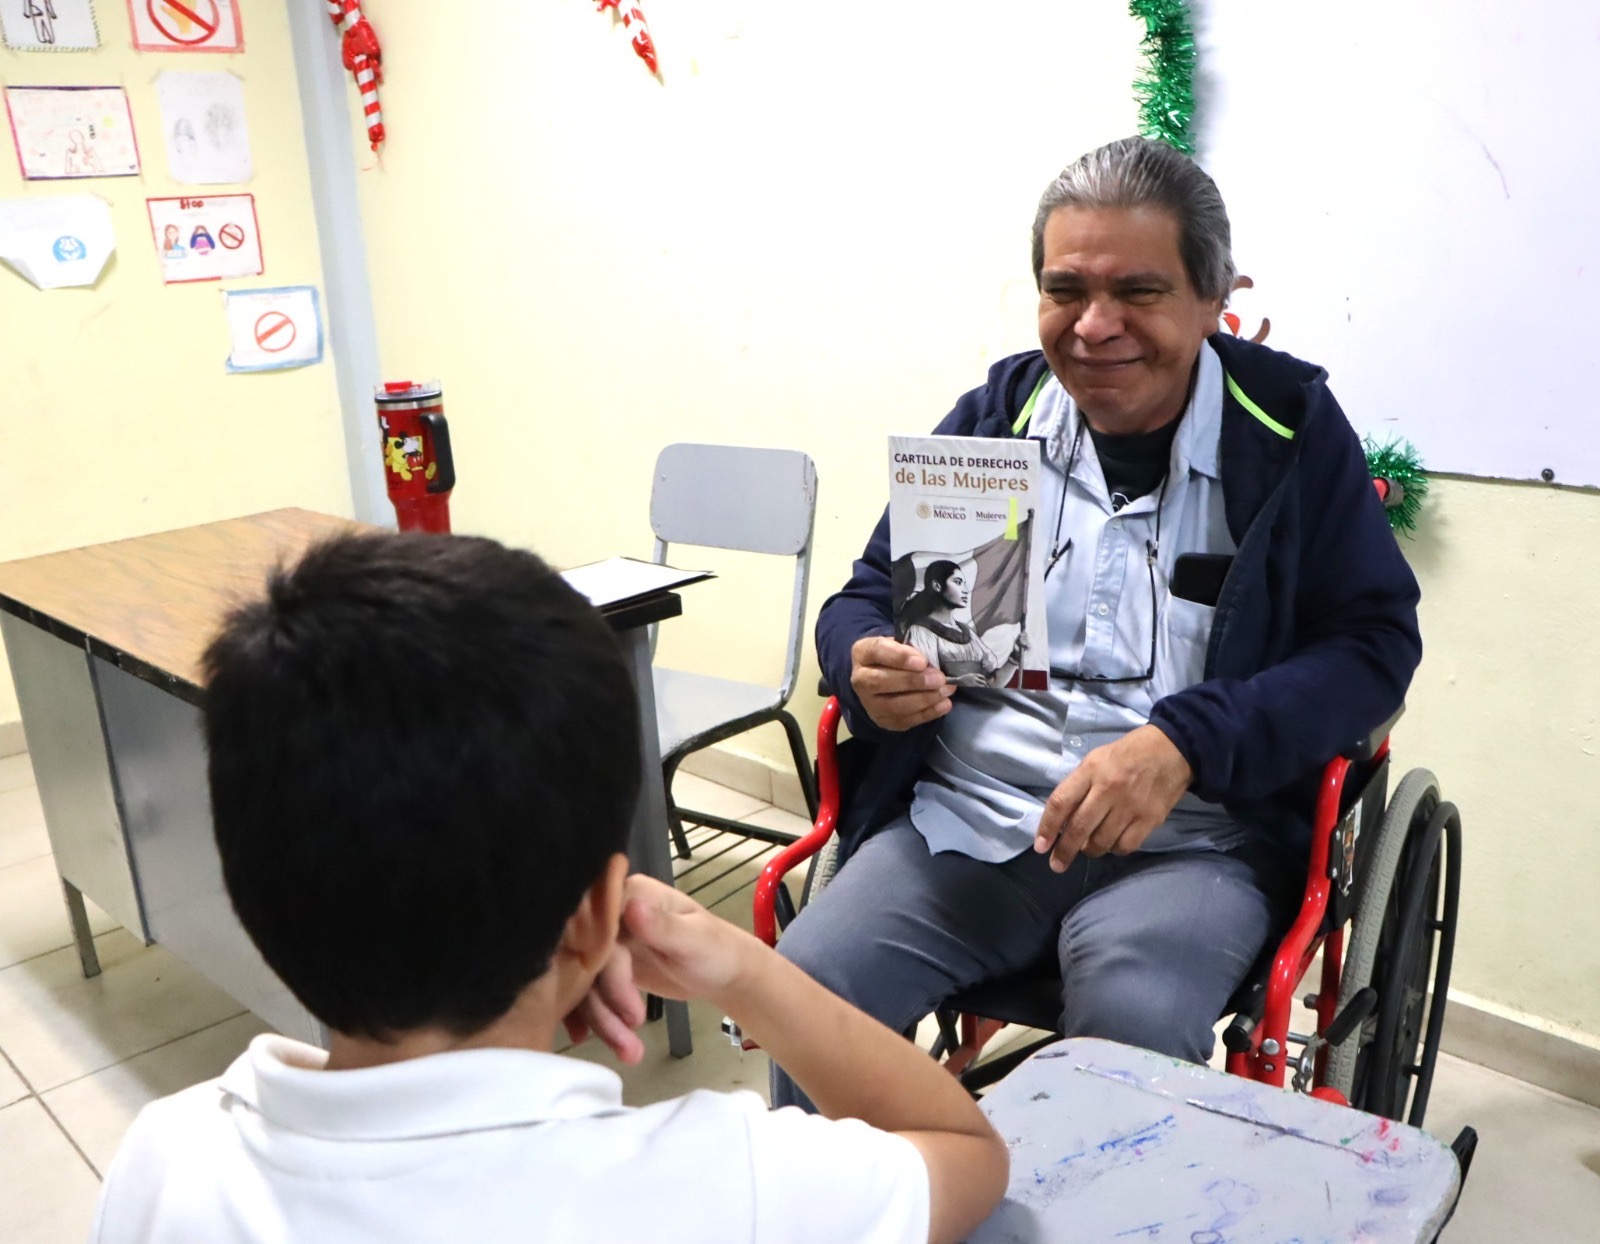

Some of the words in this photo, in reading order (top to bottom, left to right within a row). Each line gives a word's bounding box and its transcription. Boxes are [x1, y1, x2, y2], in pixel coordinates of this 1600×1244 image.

[894, 453, 947, 466] CARTILLA
[950, 457, 964, 467] DE
[967, 458, 1029, 470] DERECHOS
[895, 468, 916, 484] de
[922, 469, 947, 486] las
[953, 472, 1029, 493] Mujeres
[933, 510, 967, 520] México
[975, 511, 1007, 520] Mujeres
